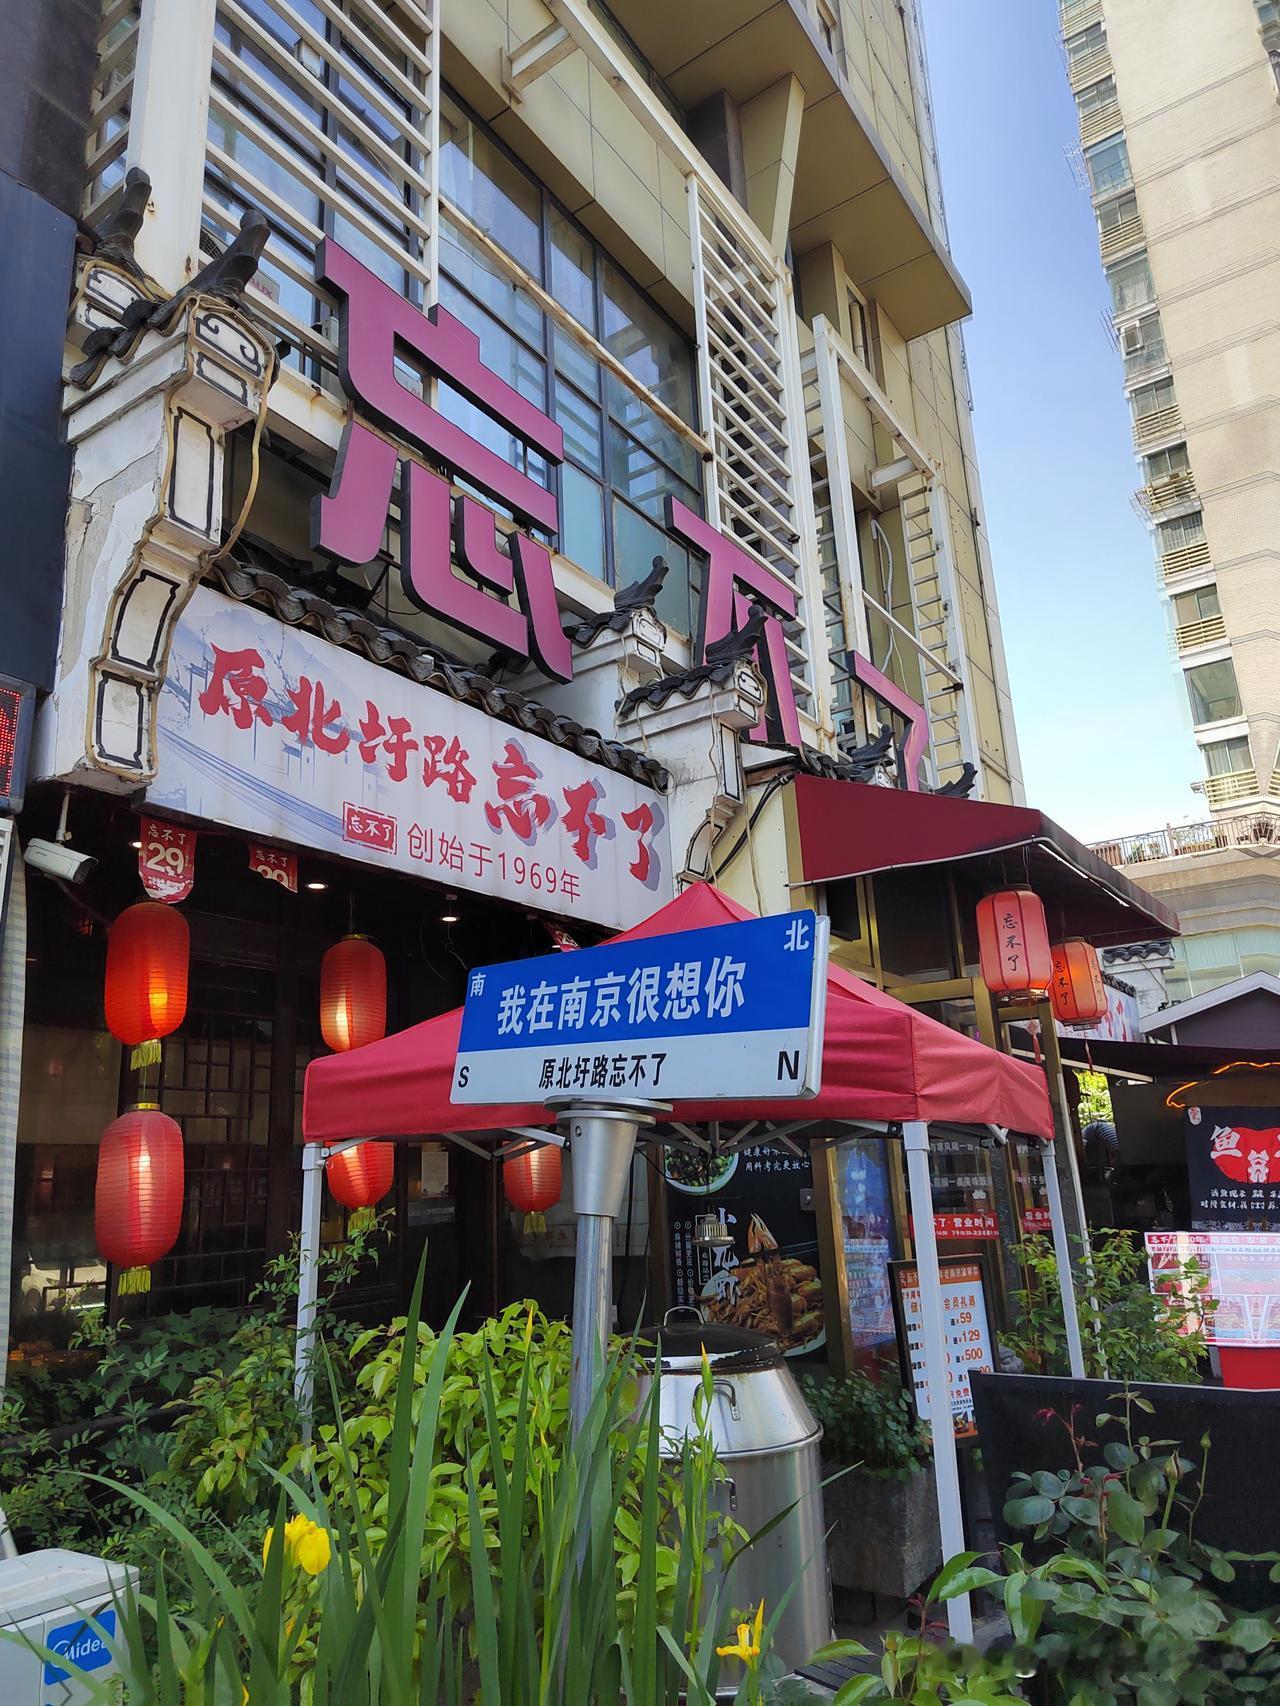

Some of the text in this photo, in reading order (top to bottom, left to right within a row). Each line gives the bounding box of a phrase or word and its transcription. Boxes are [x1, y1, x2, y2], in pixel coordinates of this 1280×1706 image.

[198, 642, 657, 883] 原北圩路忘不了
[148, 824, 186, 845] 忘不了
[347, 814, 393, 842] 忘不了
[147, 842, 185, 876] 29
[256, 849, 288, 867] 忘不了
[407, 823, 581, 903] 创始于1969年
[784, 919, 810, 951] 北
[1002, 913, 1021, 972] 忘不了
[470, 972, 486, 997] 南
[497, 955, 746, 1036] 我在南京很想你
[1054, 960, 1070, 1005] 忘不了
[458, 1066, 469, 1087] S
[538, 1053, 667, 1089] 原北圩路忘不了
[777, 1050, 799, 1080] N
